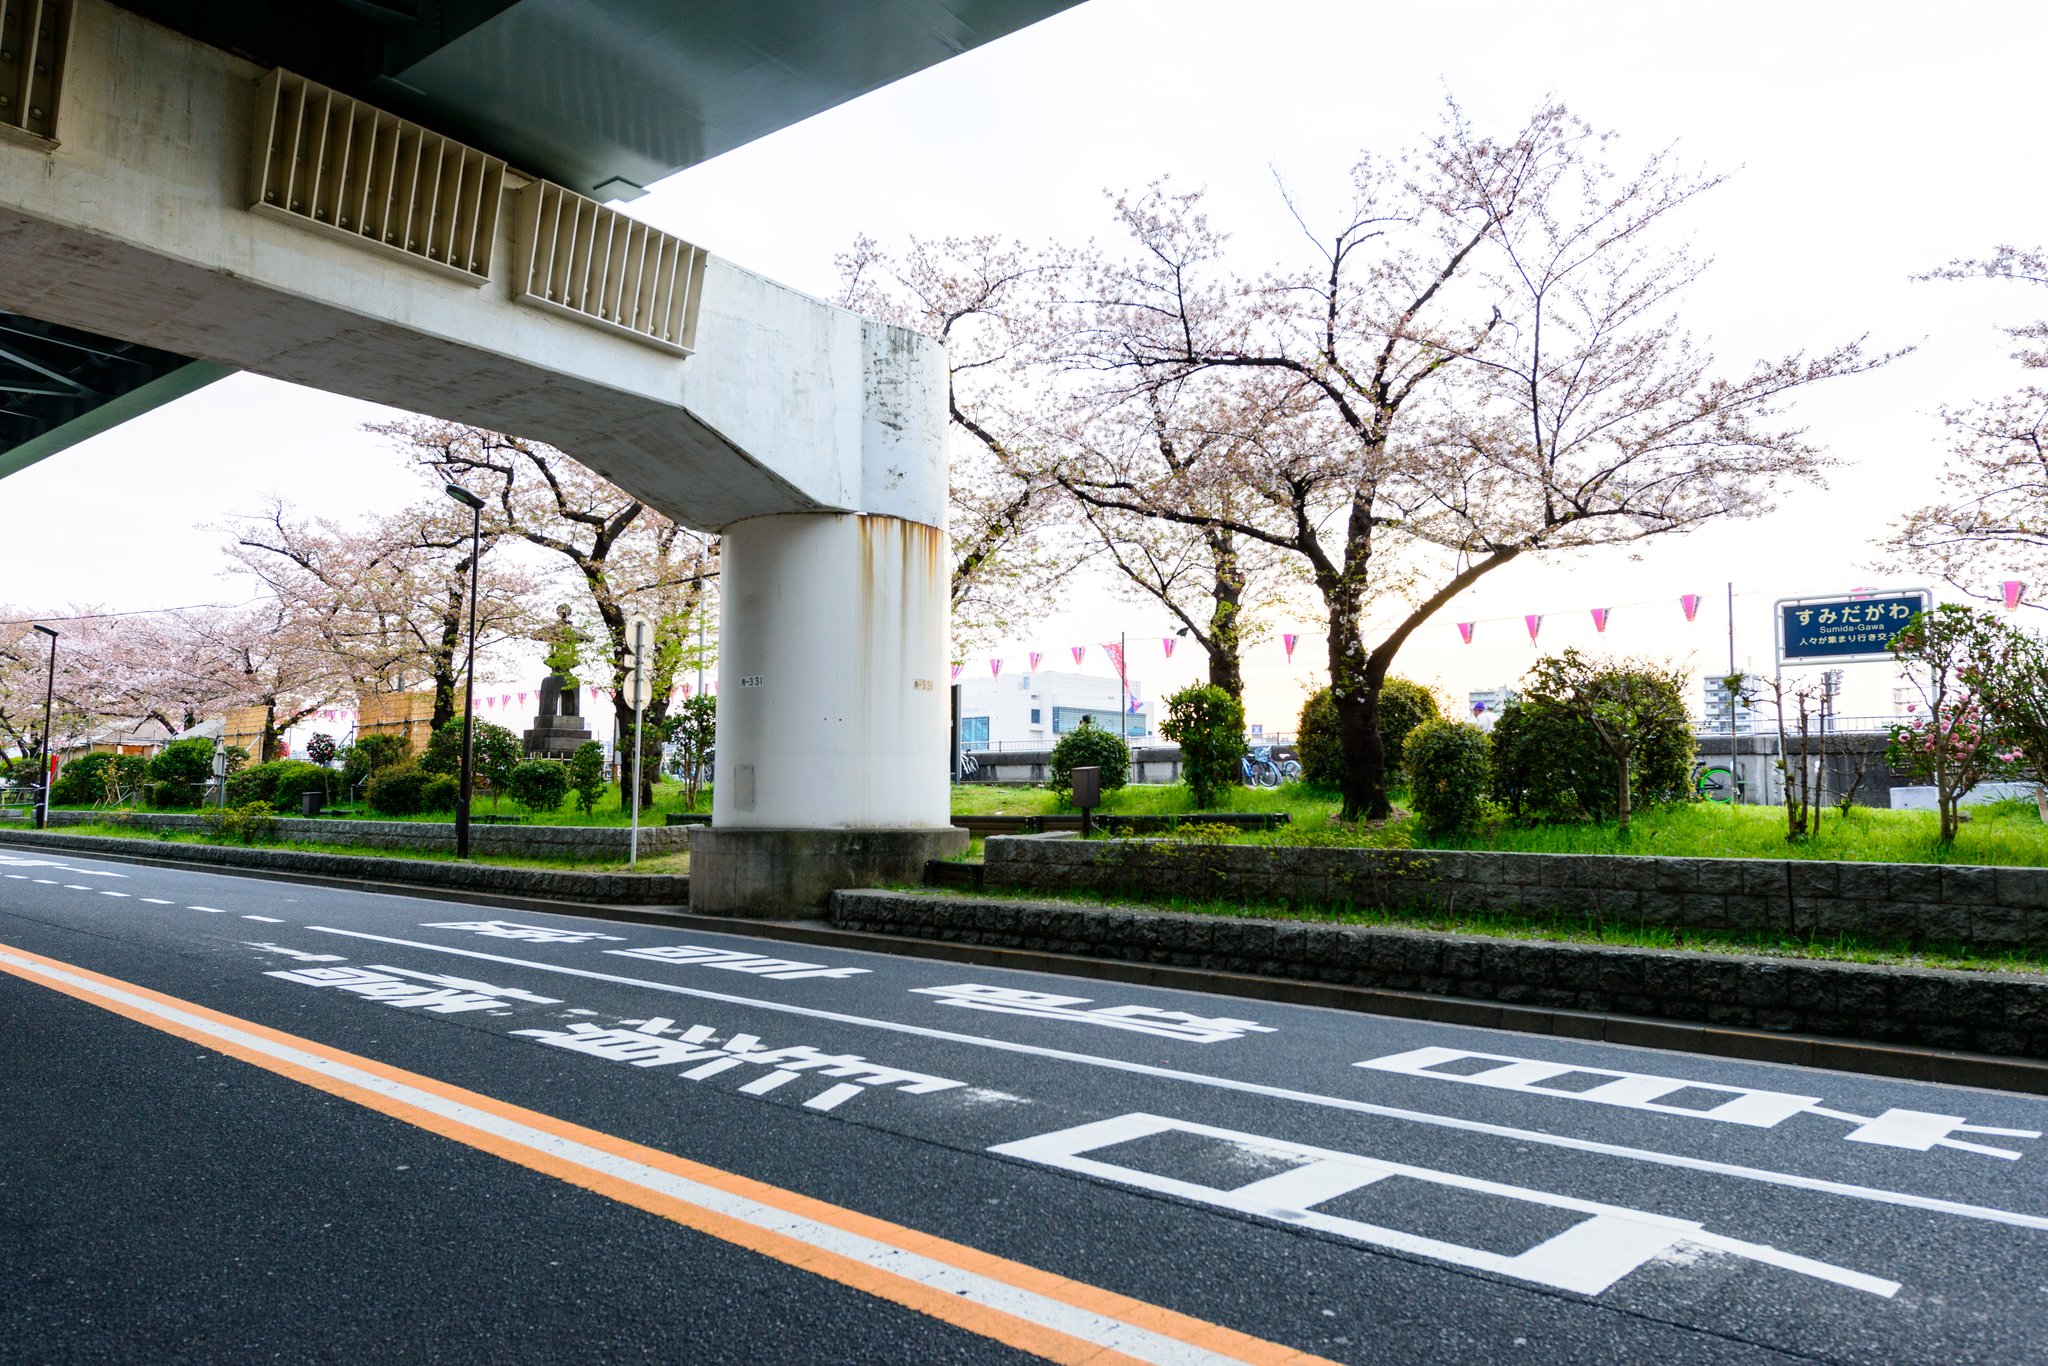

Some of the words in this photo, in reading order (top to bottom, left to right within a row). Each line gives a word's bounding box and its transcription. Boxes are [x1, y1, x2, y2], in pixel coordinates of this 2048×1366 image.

[1795, 603, 1910, 626] すみだがわ
[1819, 623, 1885, 634] Sumida-Gawa
